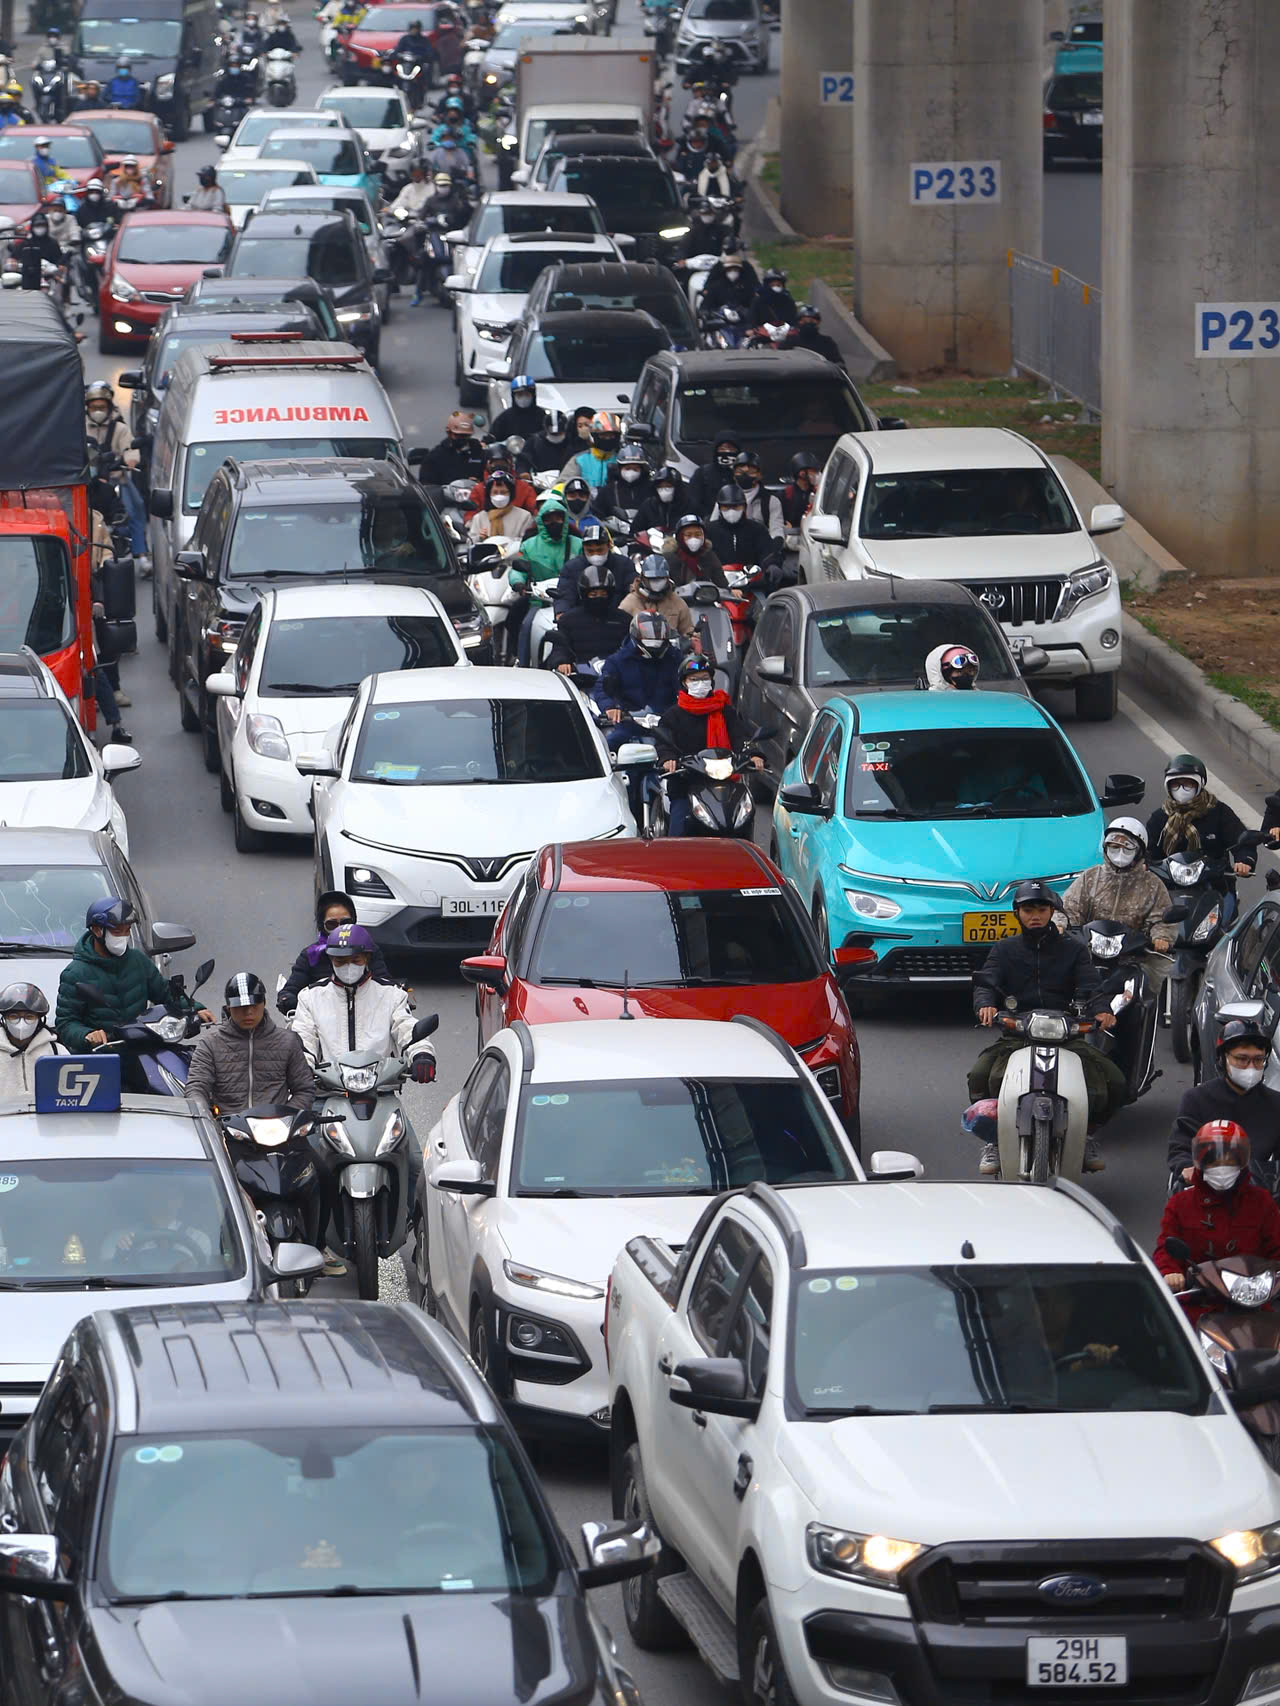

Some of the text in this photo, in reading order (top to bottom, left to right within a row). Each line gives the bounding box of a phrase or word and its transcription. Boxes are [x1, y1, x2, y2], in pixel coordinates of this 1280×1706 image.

[914, 166, 996, 200] P233
[1202, 309, 1280, 351] P23
[980, 914, 1007, 927] 29E
[57, 1063, 101, 1107] G7
[55, 1098, 78, 1107] TAXI
[1056, 1639, 1099, 1660] 29H
[1038, 1662, 1117, 1683] 584.52
